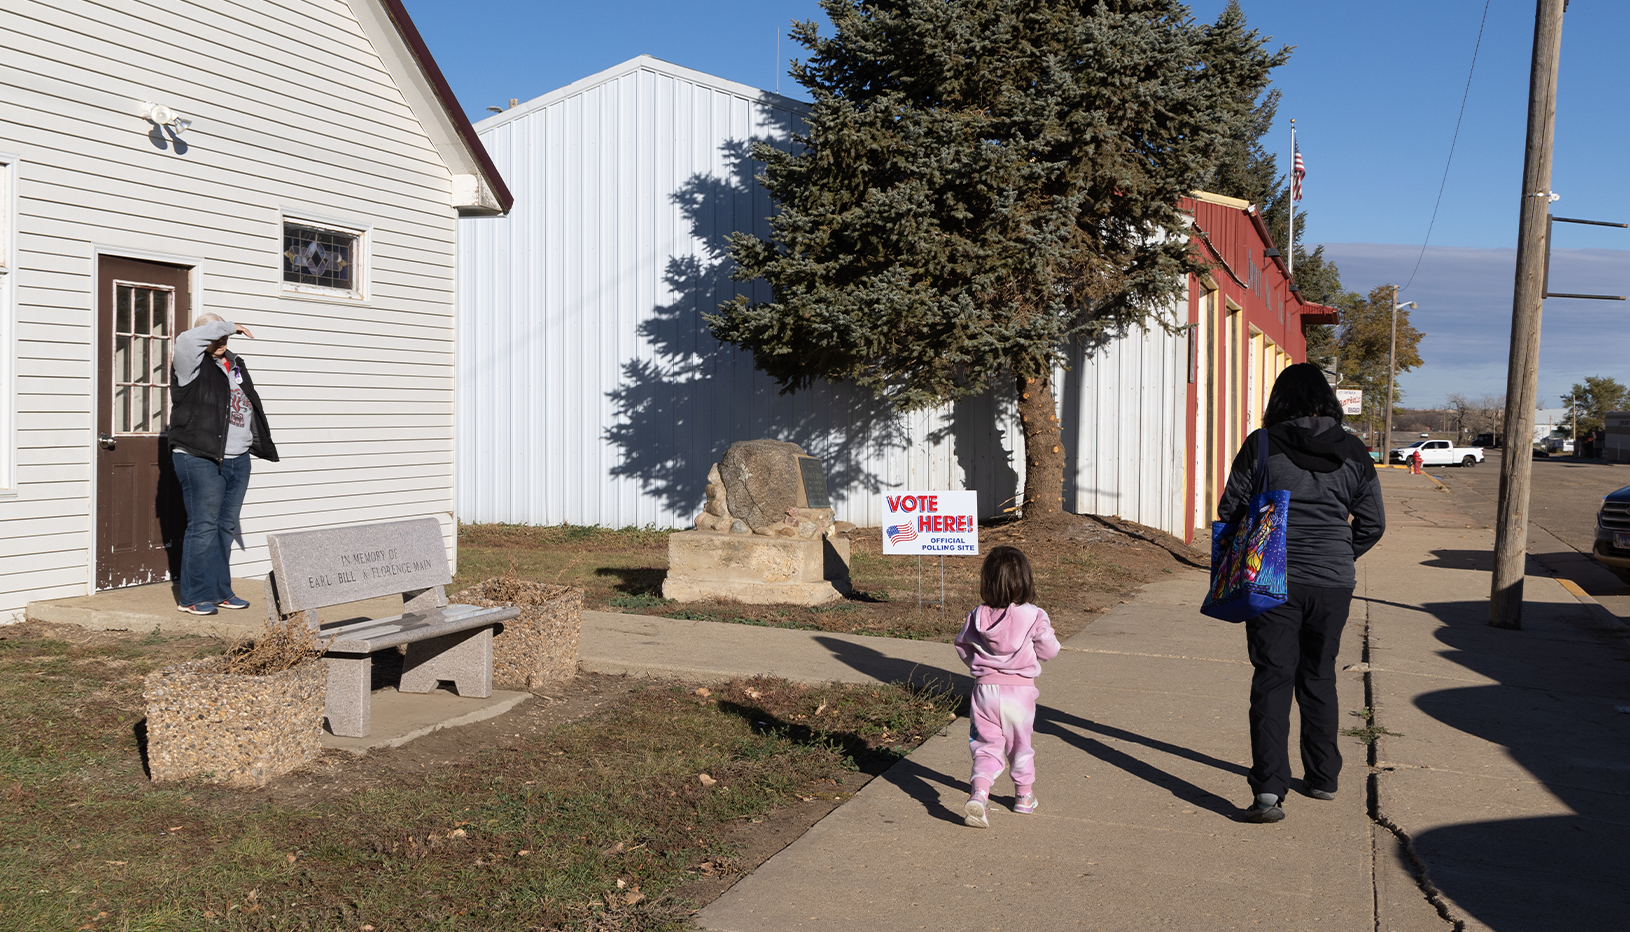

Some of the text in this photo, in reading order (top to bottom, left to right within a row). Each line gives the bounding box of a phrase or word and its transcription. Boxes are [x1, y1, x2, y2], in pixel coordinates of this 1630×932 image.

[886, 495, 938, 513] VOTE
[917, 515, 973, 533] HERE!
[340, 548, 398, 566] IN MEMORY OF
[308, 574, 332, 588] EARL
[338, 571, 356, 584] BILL
[371, 562, 411, 578] FLORENCE
[413, 559, 432, 572] MAIN
